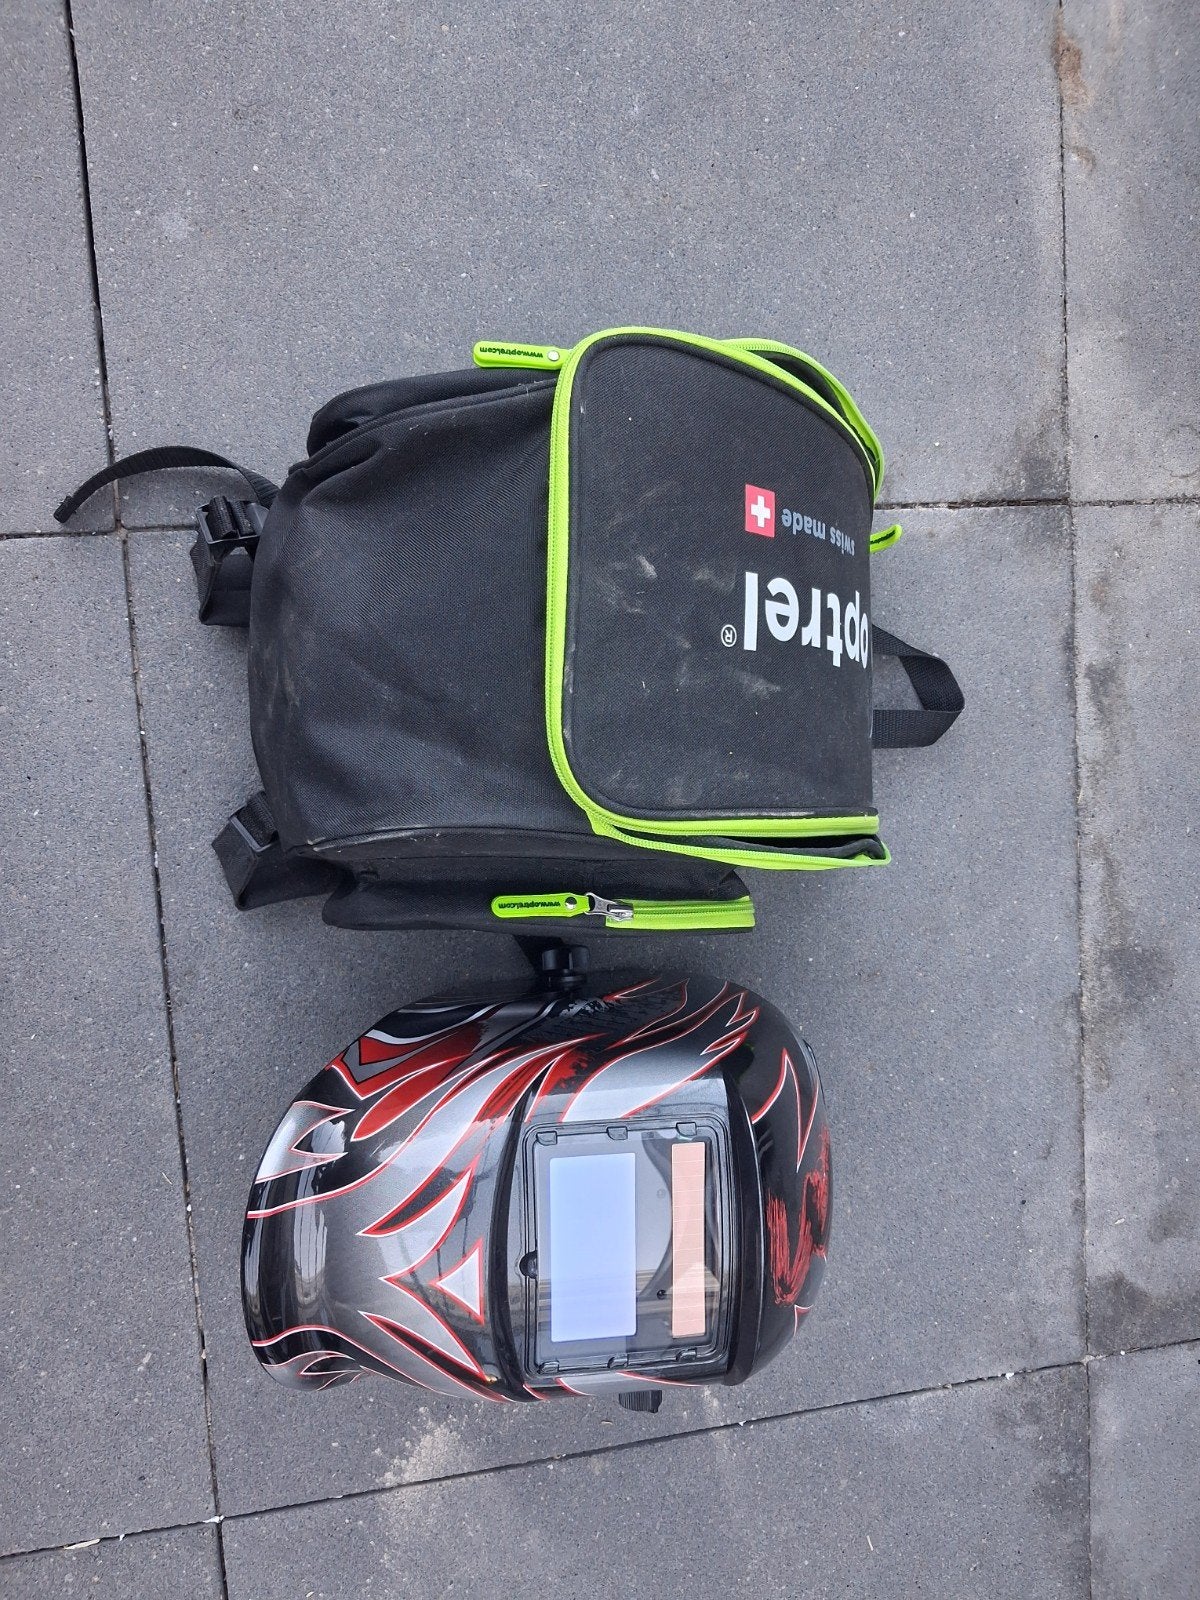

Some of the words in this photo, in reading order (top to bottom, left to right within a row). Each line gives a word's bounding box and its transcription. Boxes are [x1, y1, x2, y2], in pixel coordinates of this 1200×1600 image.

[480, 347, 543, 358] www.optrel.com
[781, 508, 826, 539] made
[829, 527, 855, 556] swiss
[498, 900, 560, 909] www.optrel.com
